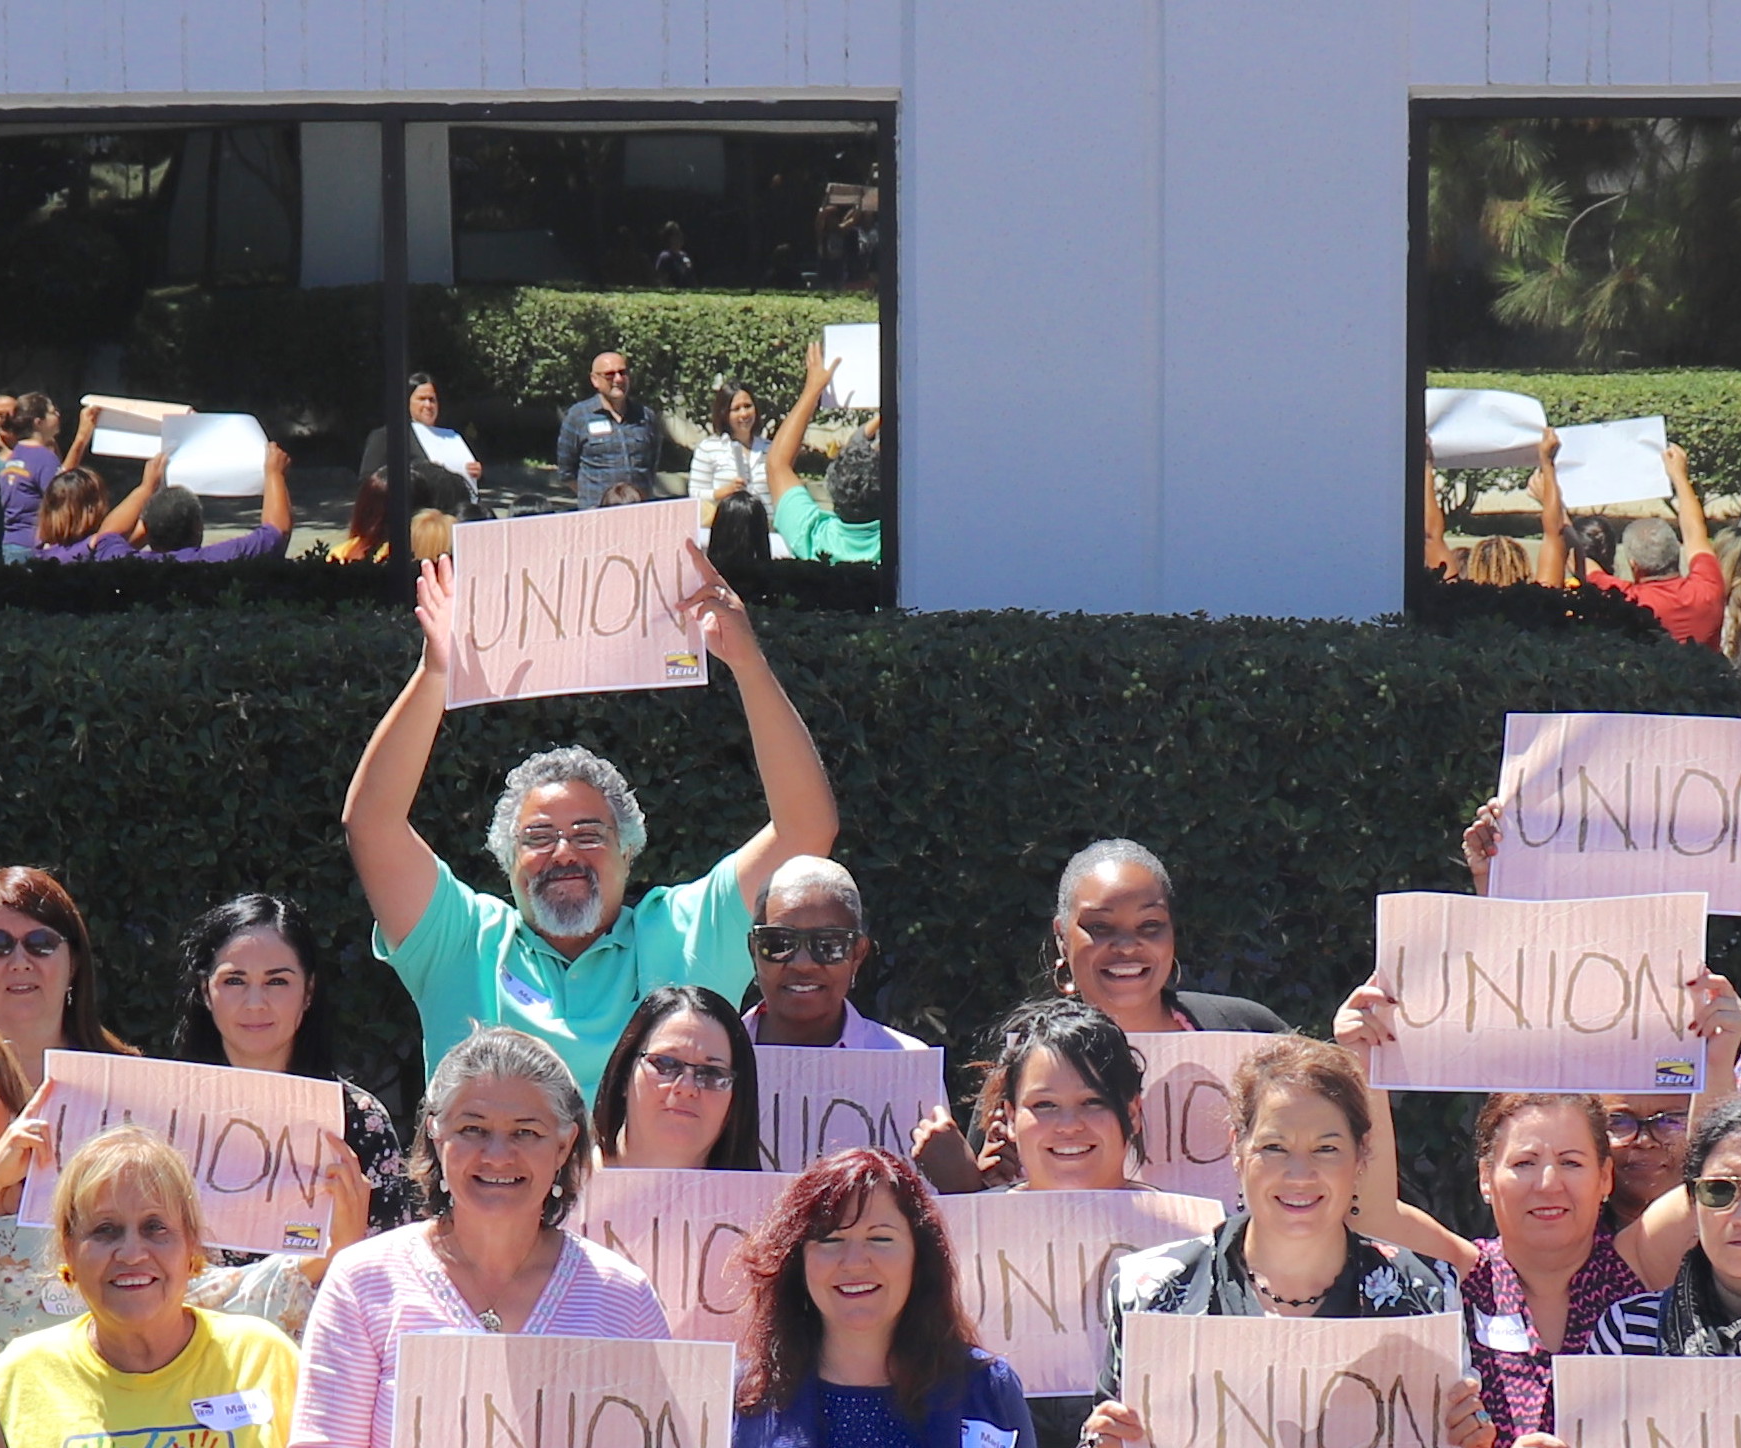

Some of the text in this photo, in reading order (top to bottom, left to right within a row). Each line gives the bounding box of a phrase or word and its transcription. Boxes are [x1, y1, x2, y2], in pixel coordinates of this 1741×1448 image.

[469, 549, 687, 651] UNION
[668, 667, 697, 675] SEIU
[1396, 945, 1685, 1042] UNION
[1656, 1076, 1693, 1084] SEIU
[284, 1237, 318, 1246] SEIU
